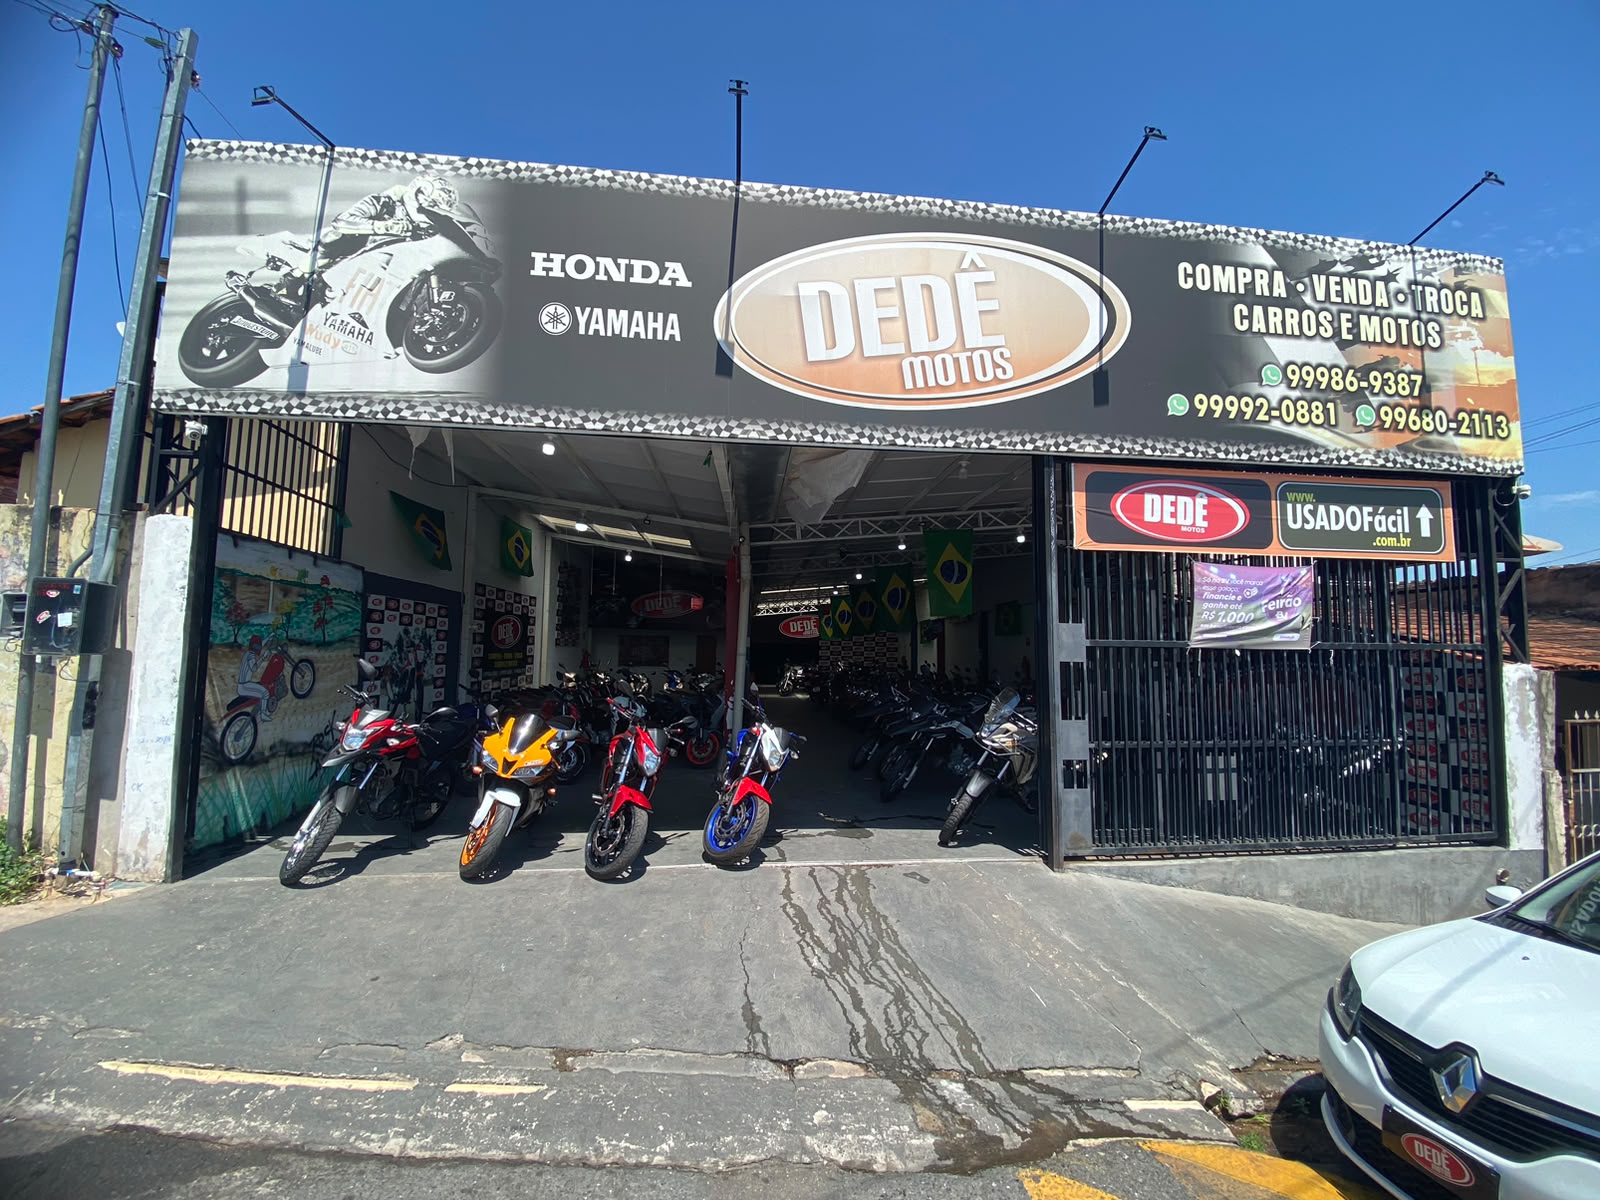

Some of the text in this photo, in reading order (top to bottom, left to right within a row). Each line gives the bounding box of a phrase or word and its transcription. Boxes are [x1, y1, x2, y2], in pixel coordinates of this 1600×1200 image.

[529, 250, 693, 288] HONDA
[797, 250, 1006, 363] DEDÊ
[1177, 261, 1485, 319] COMPRA VENDA TROCA
[323, 311, 375, 346] YAMAHA
[574, 305, 682, 343] YAMAHA
[1232, 303, 1443, 349] CARROS E MOTOS
[901, 346, 1014, 390] MOTOS
[1286, 364, 1424, 397] 99986-9387
[1193, 394, 1338, 426] 99992-0881
[1379, 405, 1510, 439] 99680-2113
[1143, 492, 1209, 528] DEDÊ
[1286, 503, 1410, 534] USADOFácil
[1181, 525, 1205, 534] MOTOS
[1372, 534, 1412, 549] .com.br
[1202, 591, 1236, 601] financie
[1202, 602, 1244, 610] ganhe até
[1262, 594, 1302, 613] Feirão
[1201, 610, 1255, 624] R$ 1.000
